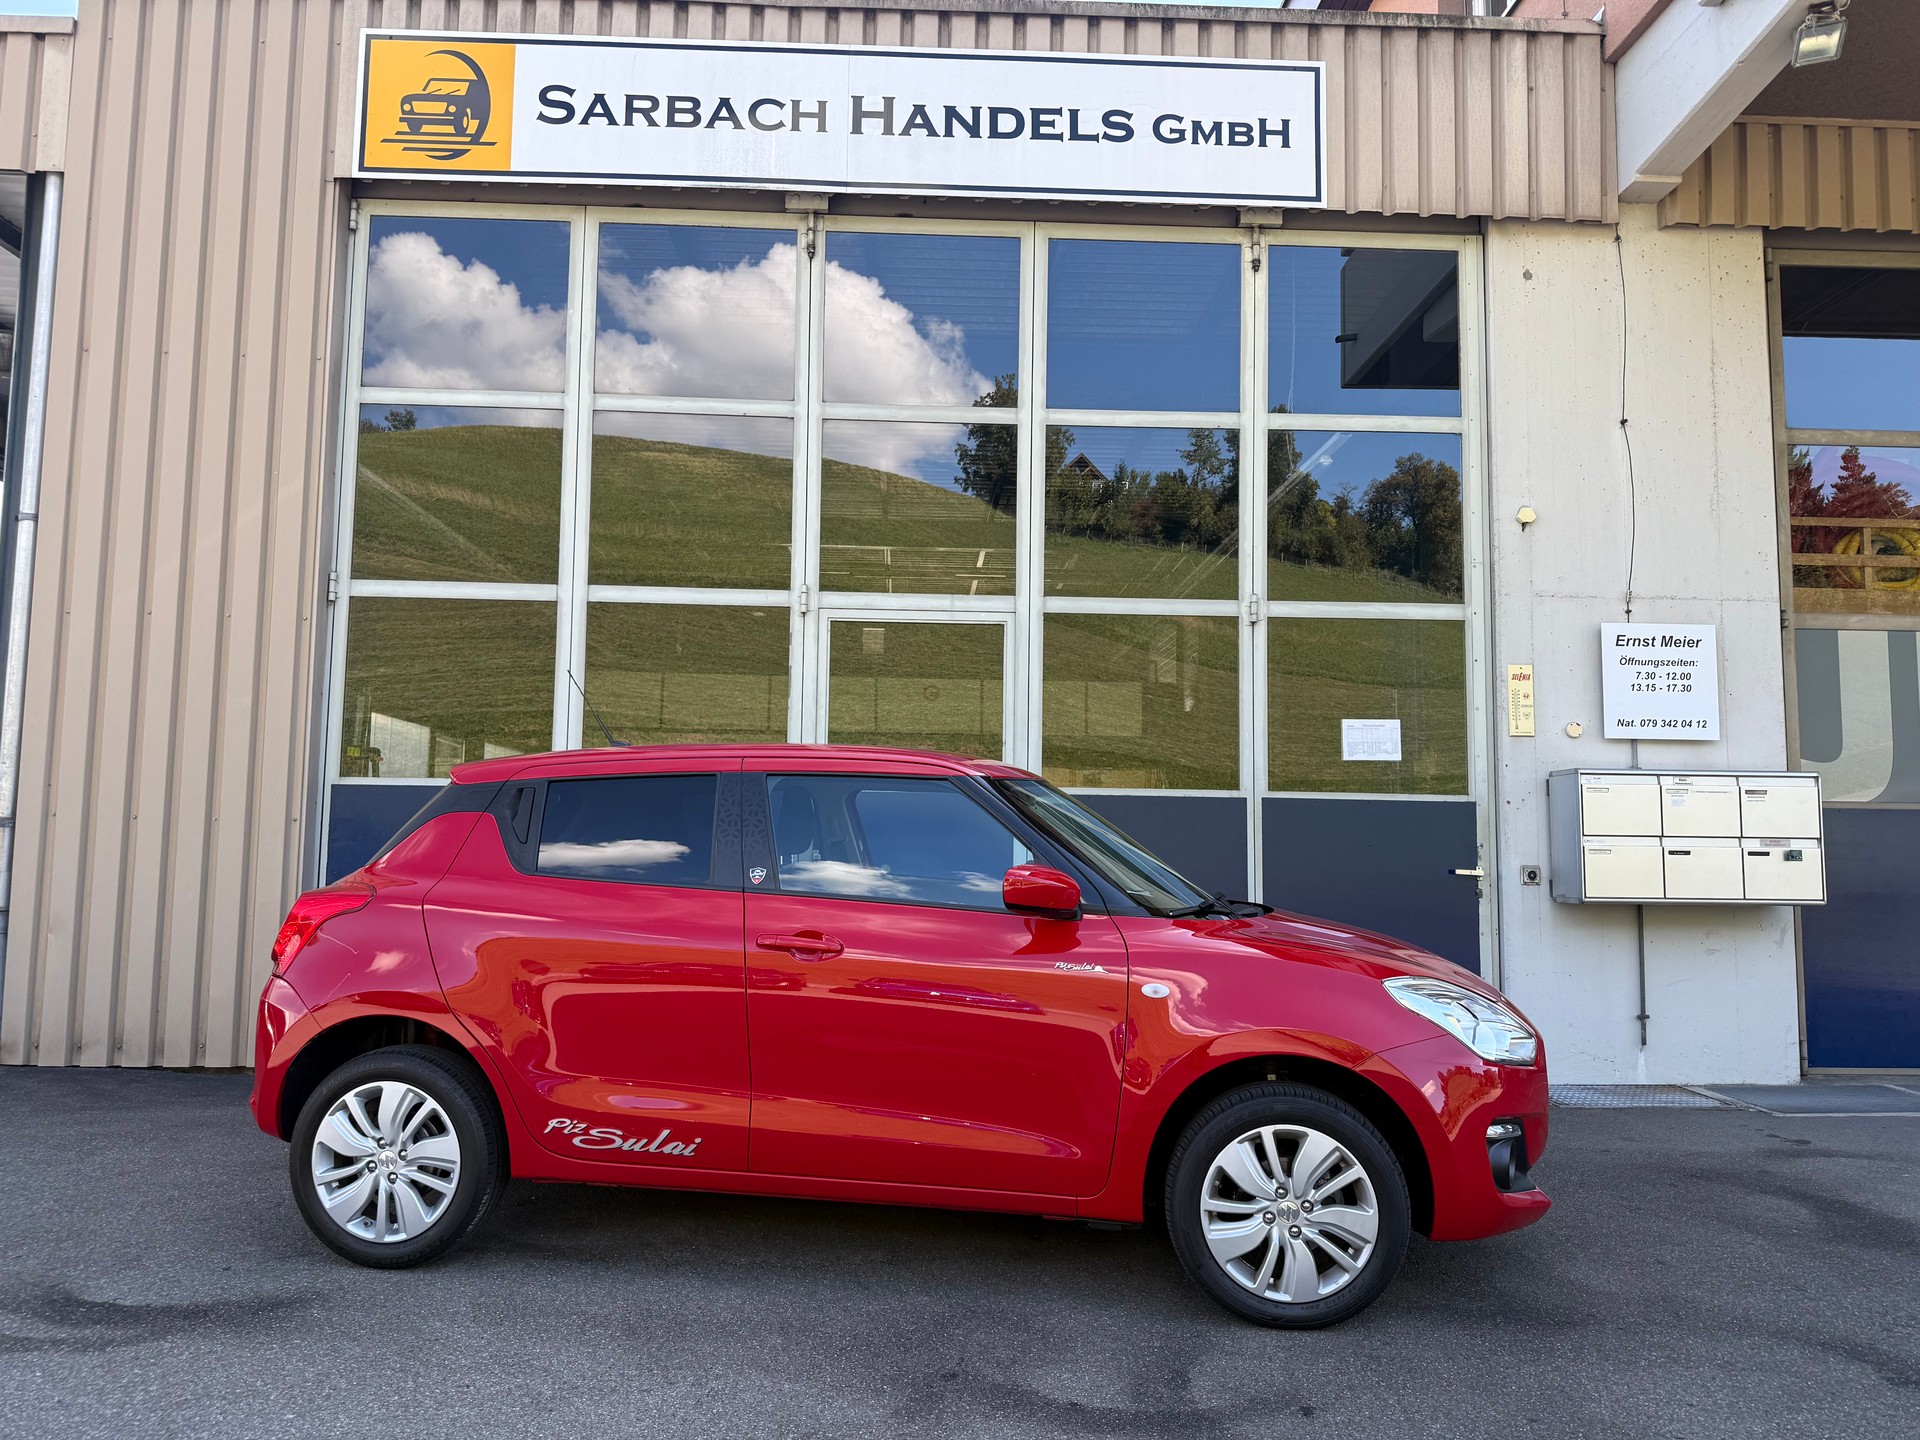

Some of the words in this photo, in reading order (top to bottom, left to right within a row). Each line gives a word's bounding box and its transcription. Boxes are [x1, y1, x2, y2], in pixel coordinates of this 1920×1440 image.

[536, 84, 828, 133] SARBACH
[849, 95, 1135, 144] HANDELS
[1615, 634, 1657, 648] Ernst
[1660, 635, 1703, 649] Meier
[1619, 655, 1699, 669] Öffnungszeiten:
[1635, 671, 1656, 681] 7.30
[1665, 672, 1692, 682] 12.00
[1630, 683, 1657, 692] 13.15
[1666, 684, 1692, 693] 17.30
[1616, 718, 1637, 728] Nat.
[1639, 719, 1658, 728] 079
[1660, 719, 1679, 729] 342
[1680, 719, 1693, 729] 04
[1695, 720, 1708, 729] 12
[543, 1117, 588, 1135] Piz
[571, 1127, 702, 1157] Sulai
